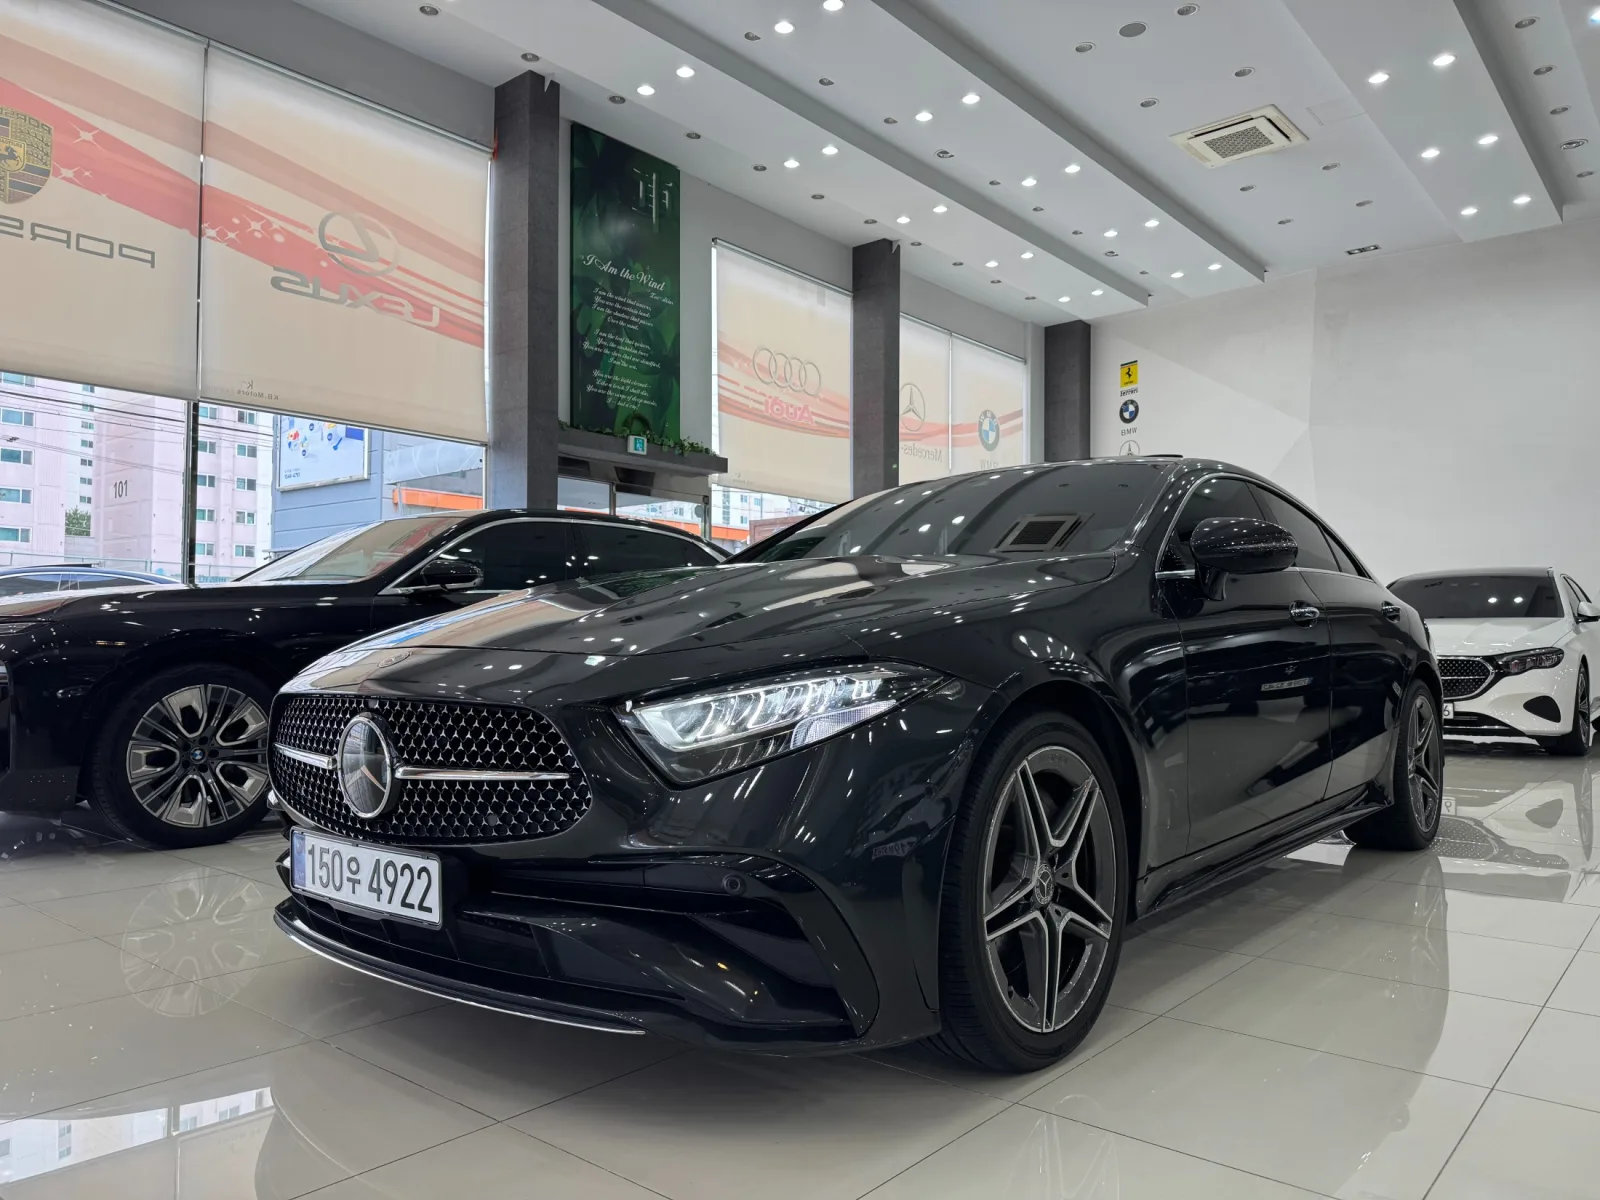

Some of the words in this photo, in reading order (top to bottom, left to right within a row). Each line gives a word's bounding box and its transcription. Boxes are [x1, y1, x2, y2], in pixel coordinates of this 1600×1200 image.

[595, 259, 618, 275] Am
[620, 268, 635, 280] the
[636, 272, 665, 291] Wind
[1121, 427, 1137, 436] BMW
[113, 480, 128, 498] 101
[308, 844, 360, 894] 150우
[368, 858, 432, 914] 4922
